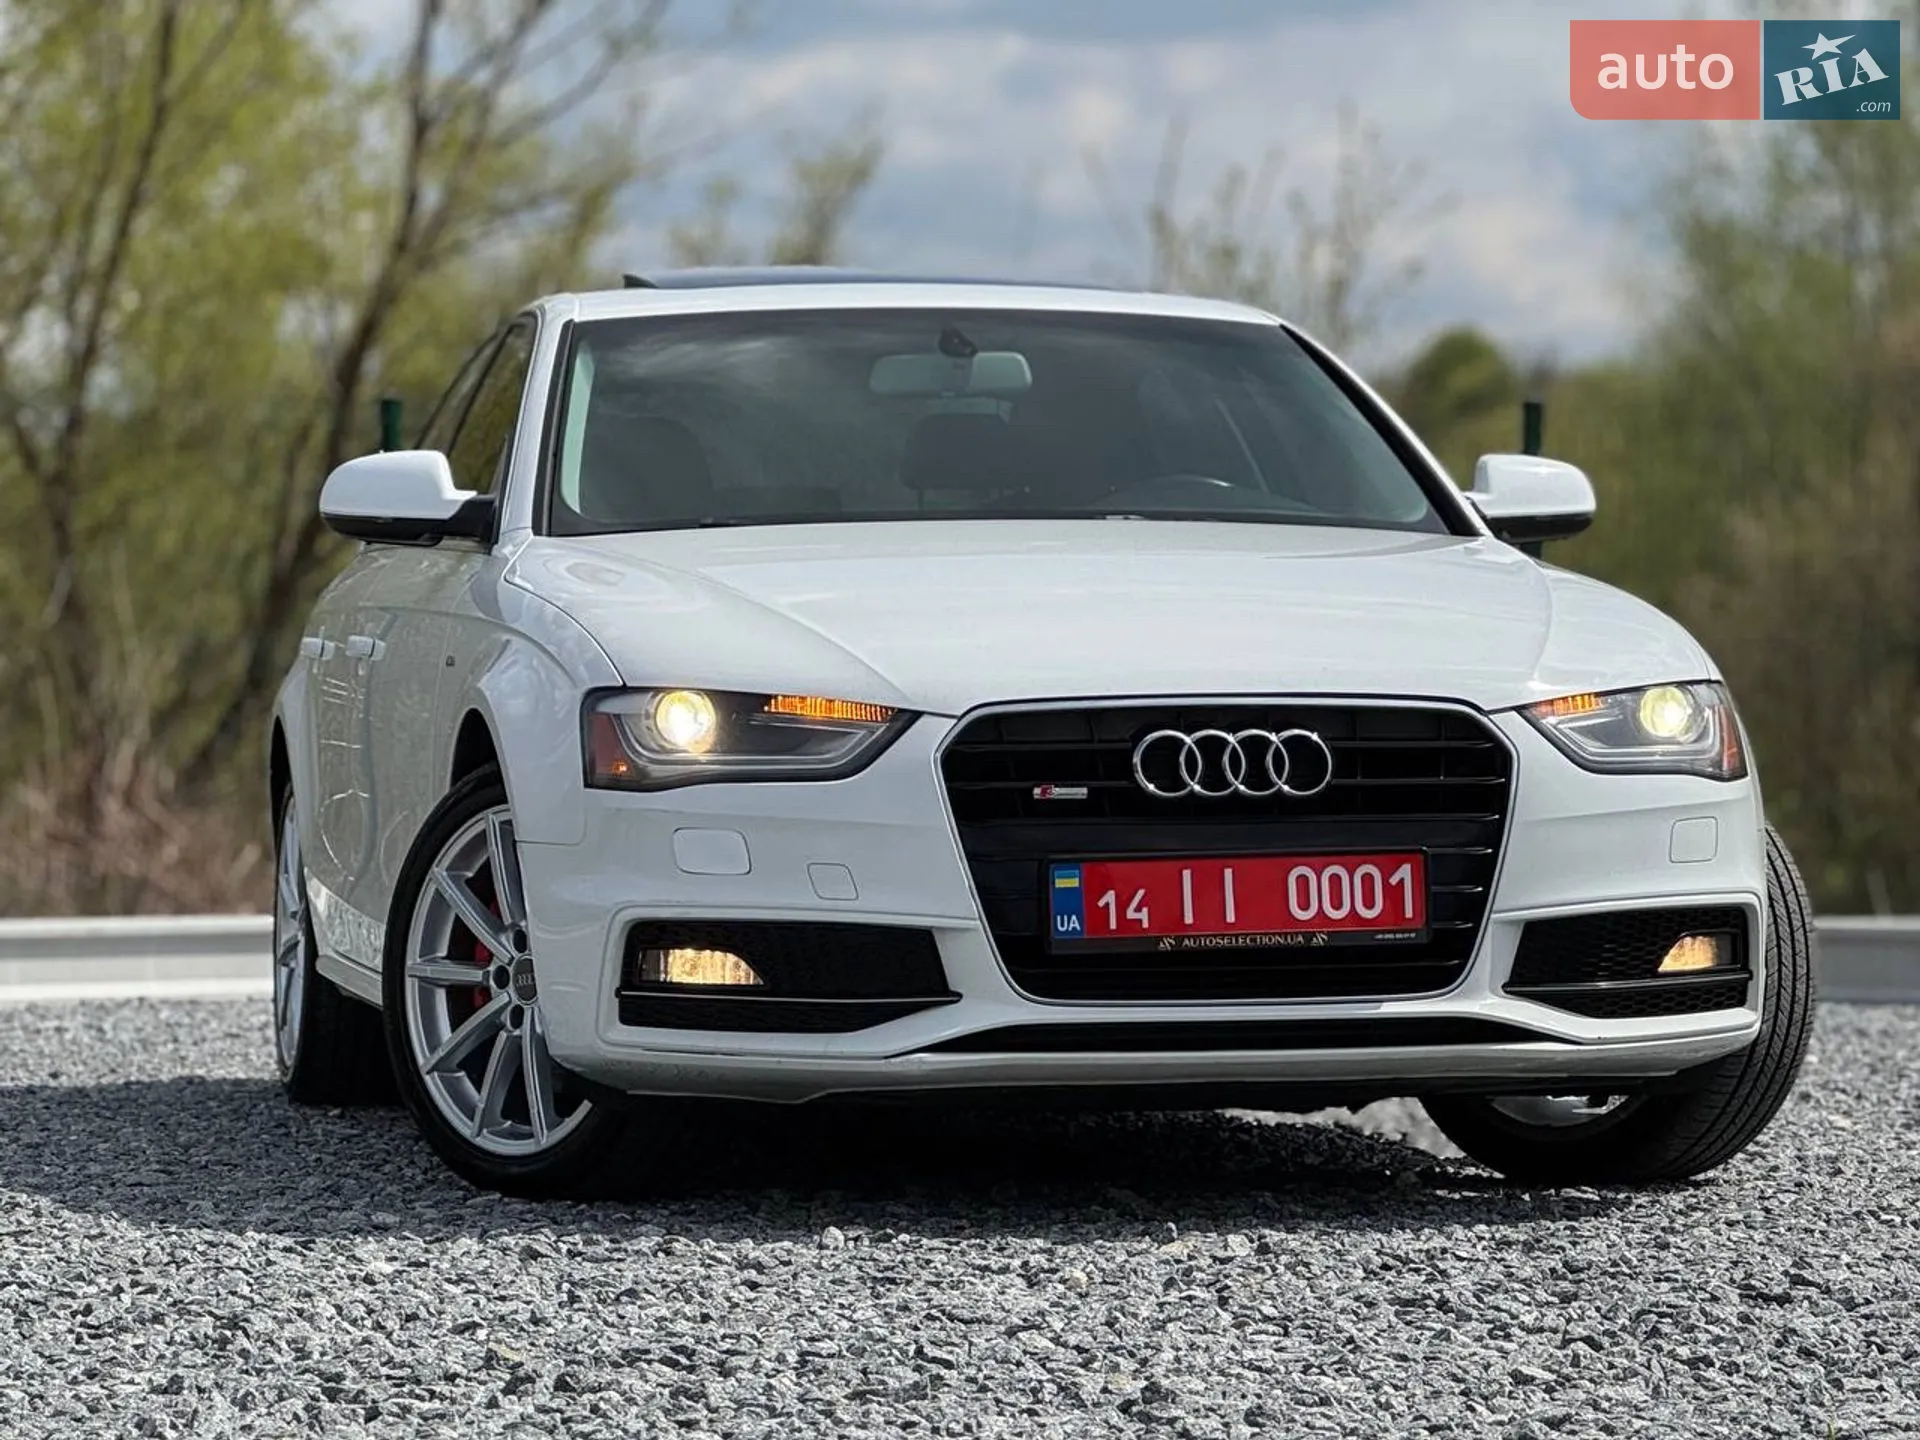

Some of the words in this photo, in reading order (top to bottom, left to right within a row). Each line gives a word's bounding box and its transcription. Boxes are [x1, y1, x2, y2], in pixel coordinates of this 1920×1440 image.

[1096, 889, 1150, 930] 14
[1287, 863, 1414, 921] 0001
[1056, 914, 1081, 932] UA
[1182, 935, 1304, 948] AUTOSELECTION.UA
